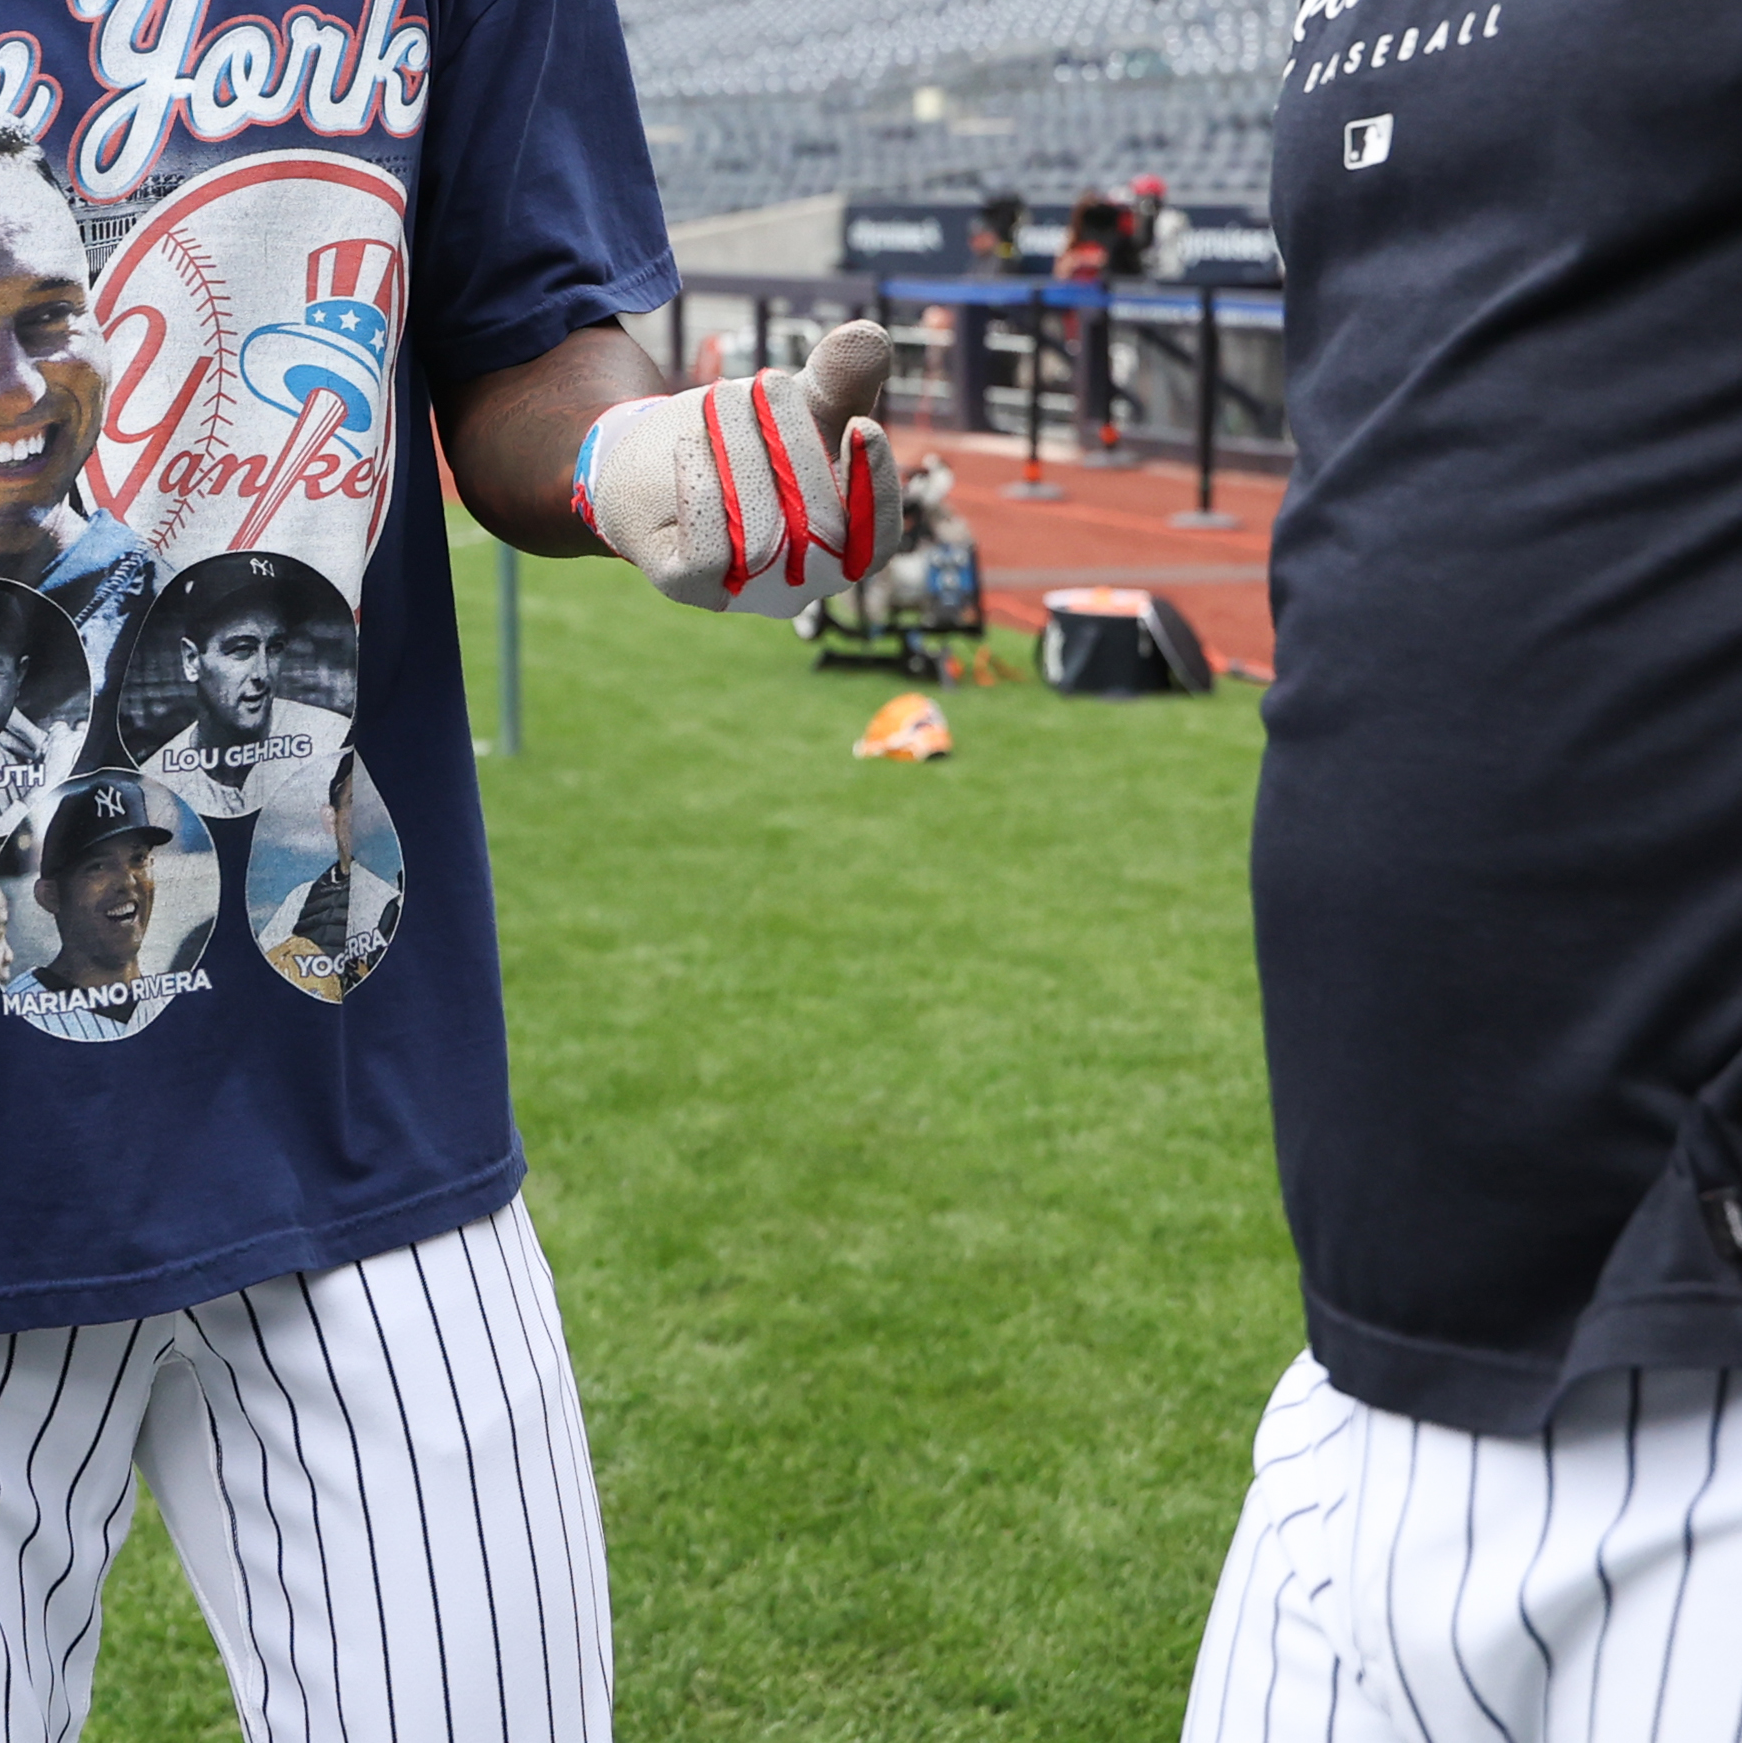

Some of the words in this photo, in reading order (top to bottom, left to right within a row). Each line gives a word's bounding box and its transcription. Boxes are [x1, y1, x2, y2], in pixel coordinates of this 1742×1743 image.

[1303, 2, 1502, 94] BASEBALL
[163, 747, 220, 773] LOU
[223, 733, 314, 769] GEHRIG
[1, 981, 129, 1017] MARIANO
[130, 967, 213, 1002] RIVERA
